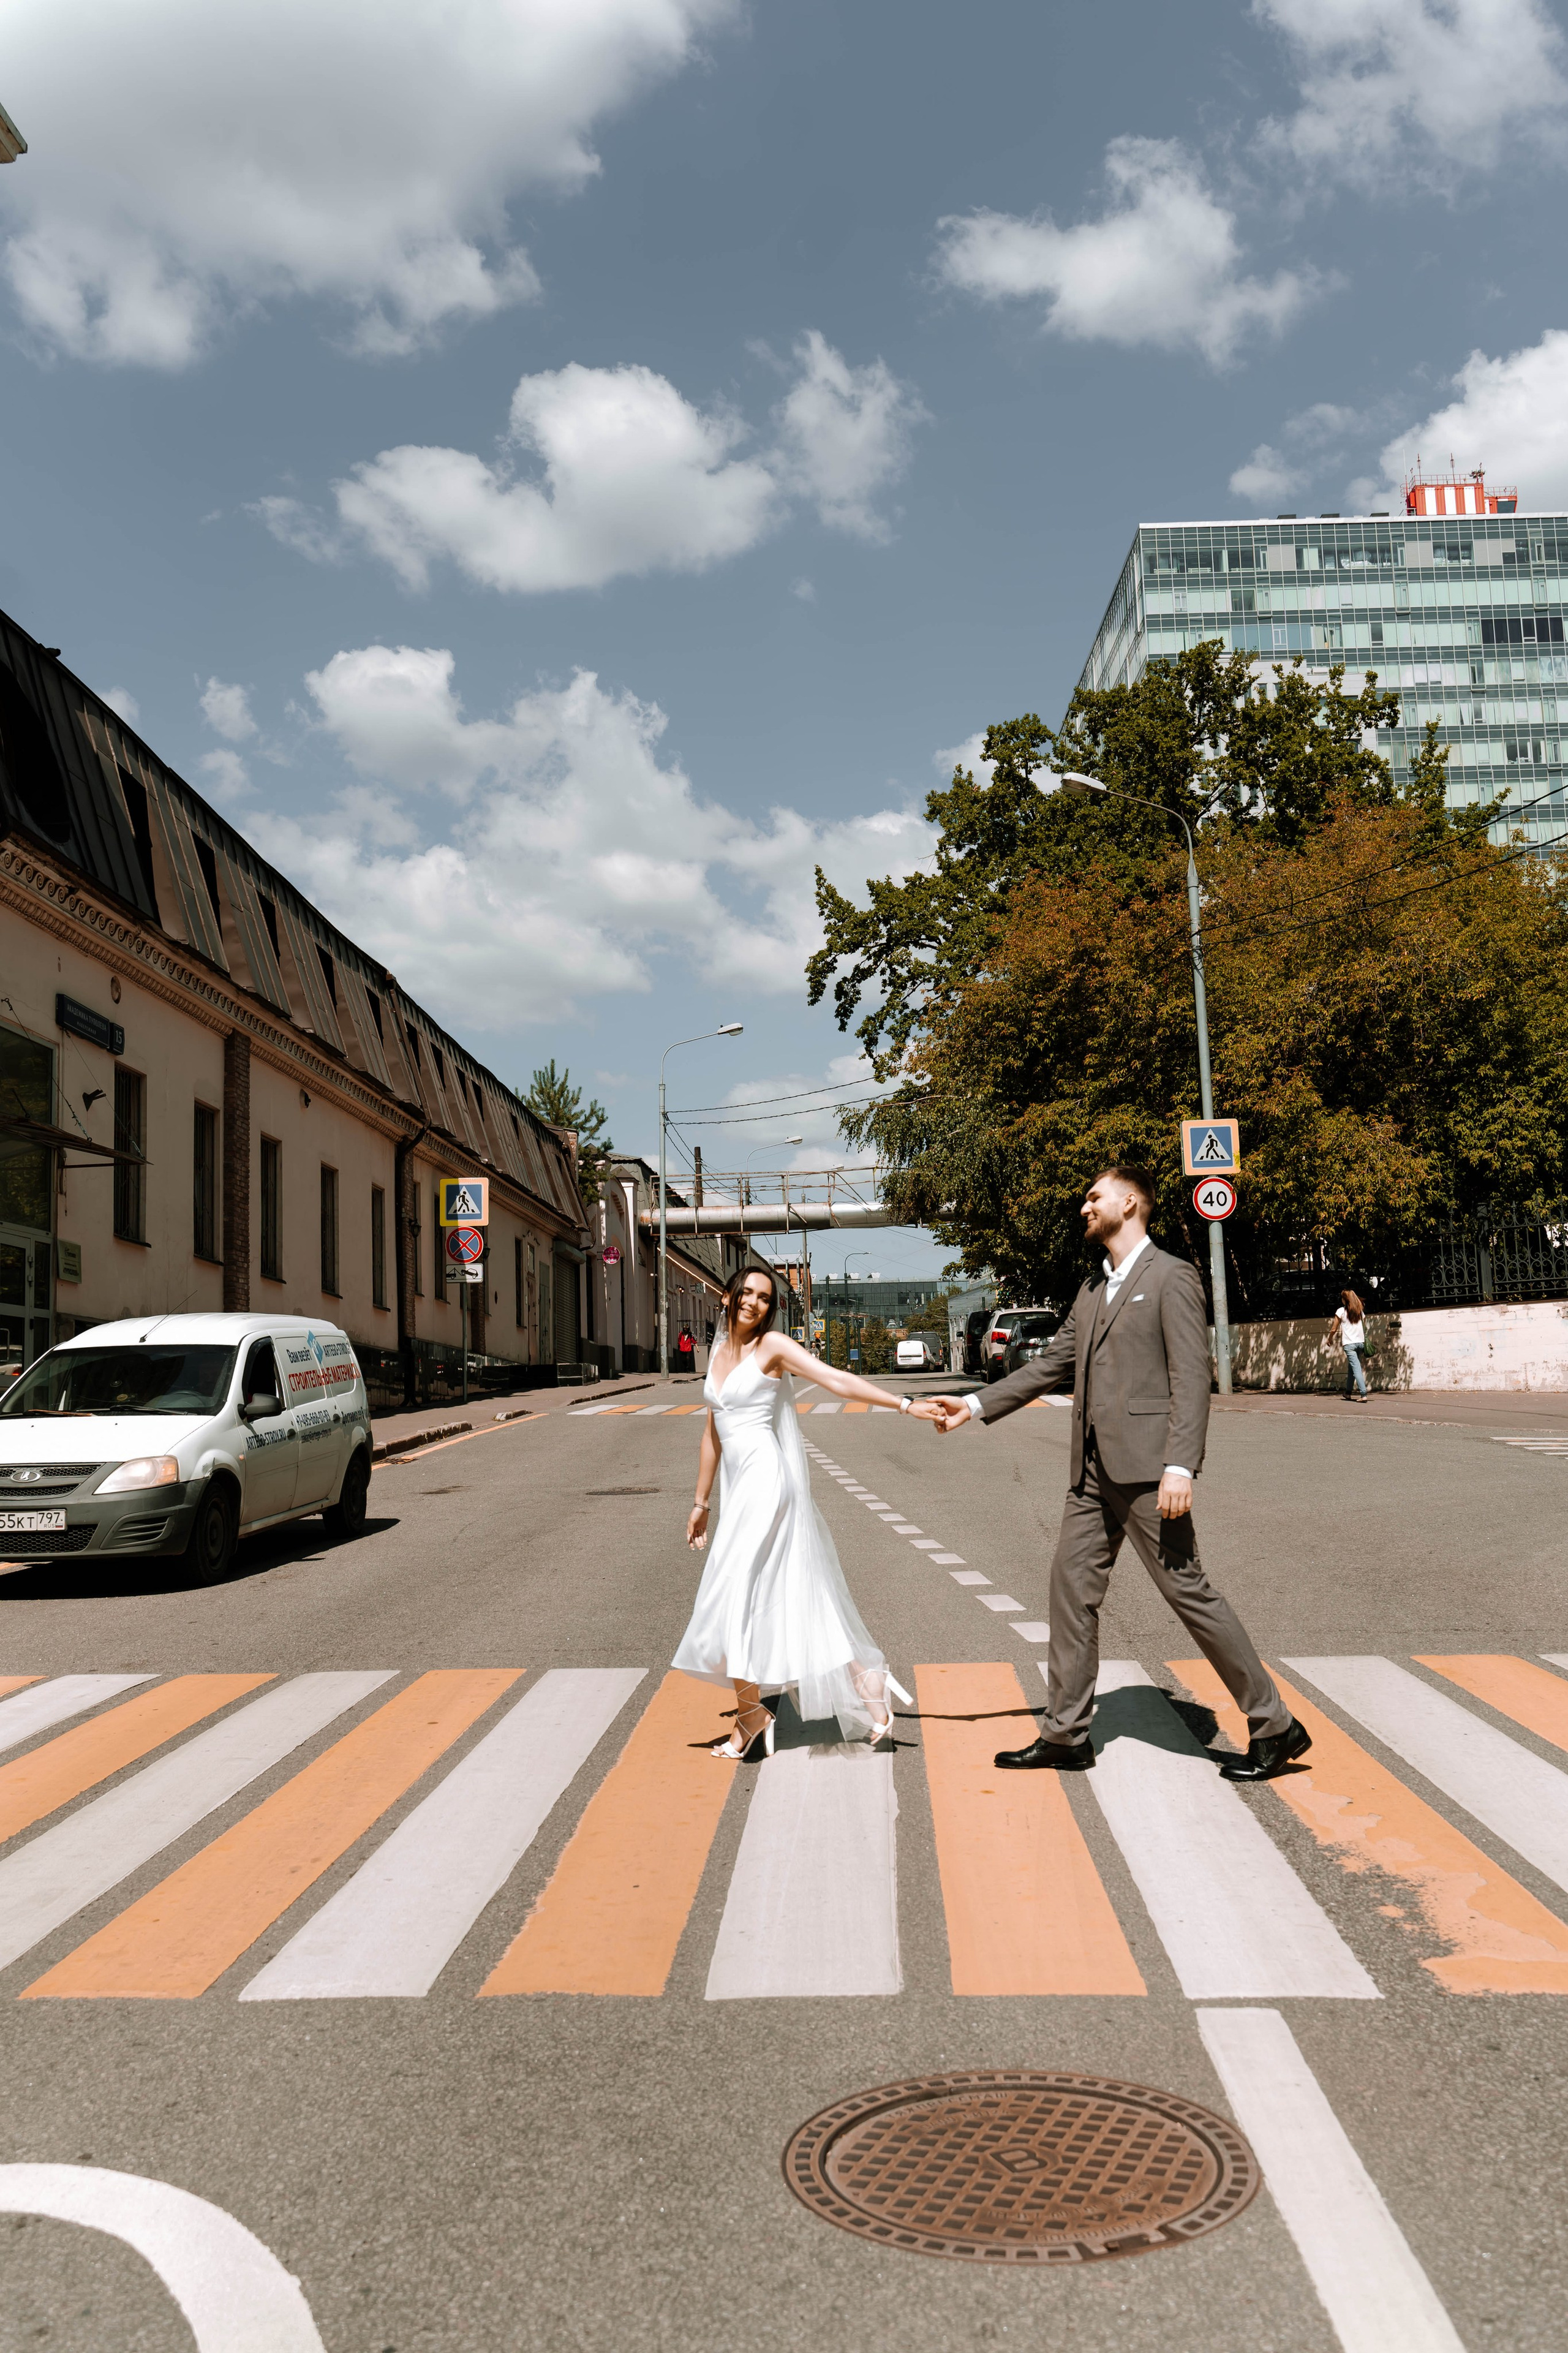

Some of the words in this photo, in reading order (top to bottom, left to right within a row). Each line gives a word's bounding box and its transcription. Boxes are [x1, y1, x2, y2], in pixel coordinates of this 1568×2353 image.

[67, 1003, 89, 1022] АКАДЕМИКА
[89, 1016, 107, 1032] ТУПОЛЕВА
[115, 1030, 122, 1044] 15
[1202, 1191, 1227, 1207] 40
[286, 1349, 300, 1364] Вам
[288, 1367, 333, 1392] СТРОИТЕЛЬНЫЕ
[330, 1362, 361, 1384] МАТЕРИАЛЫ
[246, 1428, 286, 1451] ARTEGO-STROY.RU
[38, 1512, 60, 1524] 797
[1033, 2206, 1174, 2243] МОСВОДОКАНАЛ
